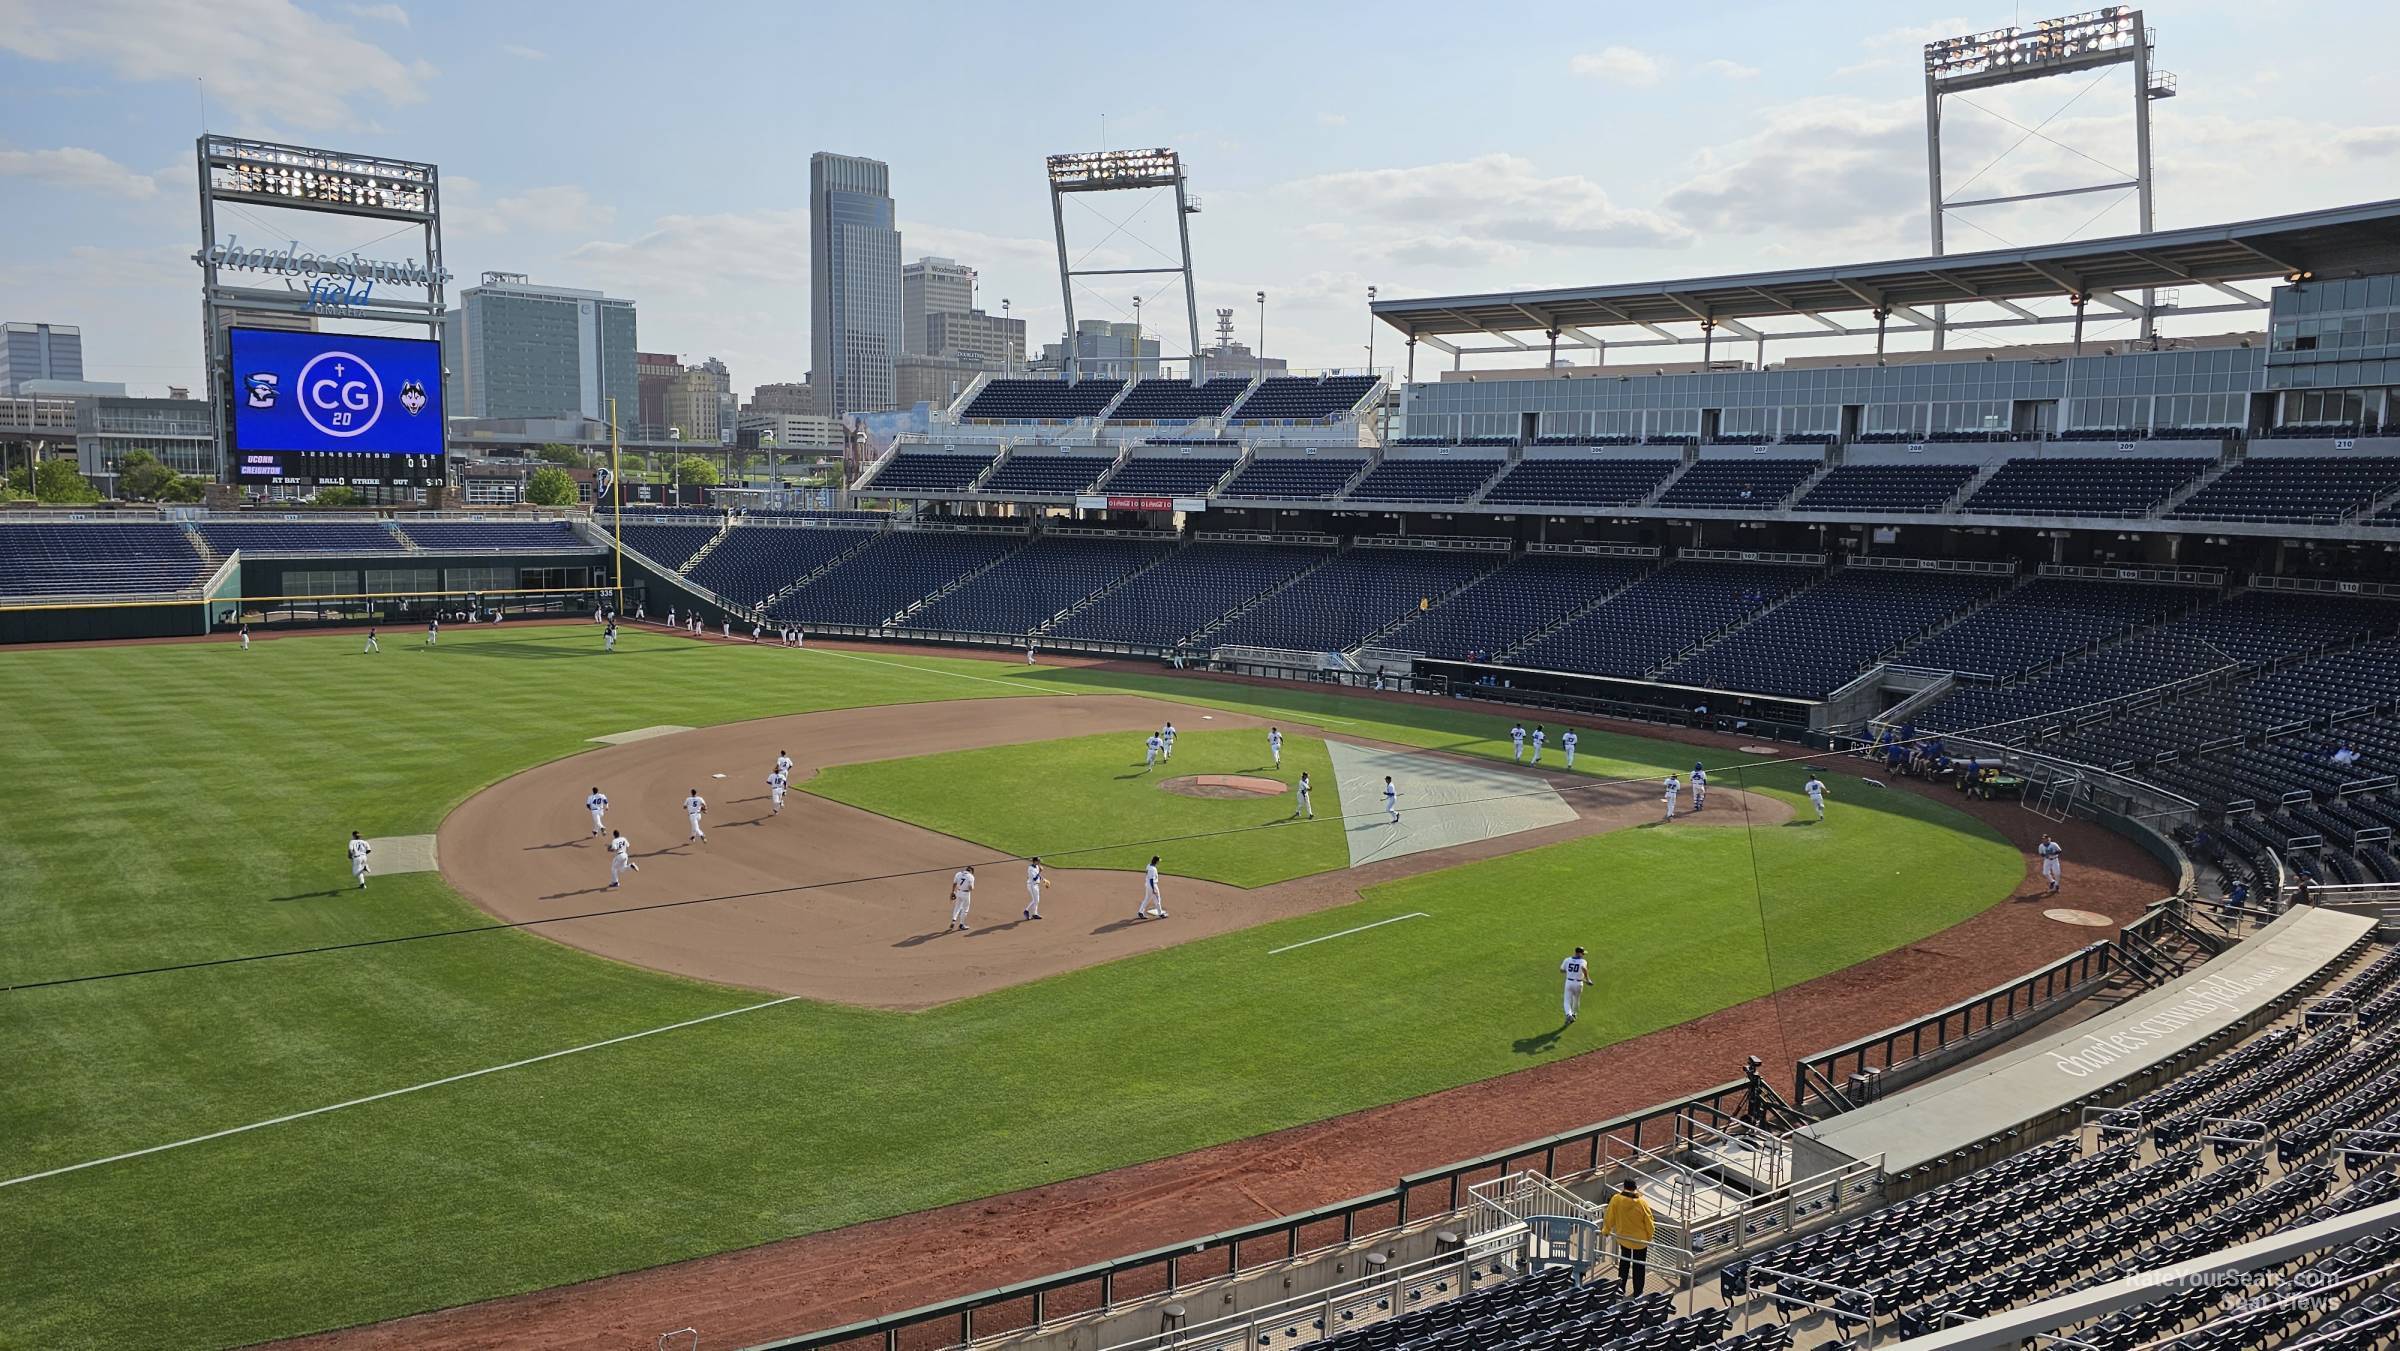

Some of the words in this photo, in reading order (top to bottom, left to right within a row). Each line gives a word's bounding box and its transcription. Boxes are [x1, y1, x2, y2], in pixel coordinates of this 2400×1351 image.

[205, 234, 328, 275] charles
[300, 277, 373, 309] field
[314, 305, 367, 319] OMAHA
[312, 379, 369, 410] CG
[332, 412, 351, 426] 20
[2337, 440, 2352, 448] 210
[248, 455, 273, 464] UCONN
[408, 458, 414, 468] 0
[421, 459, 428, 468] 0
[241, 466, 281, 475] CREIGHTON
[1568, 963, 1580, 972] 50
[2047, 1026, 2149, 1077] charles
[2139, 997, 2218, 1039] SCHWAB
[2186, 974, 2254, 1012] field
